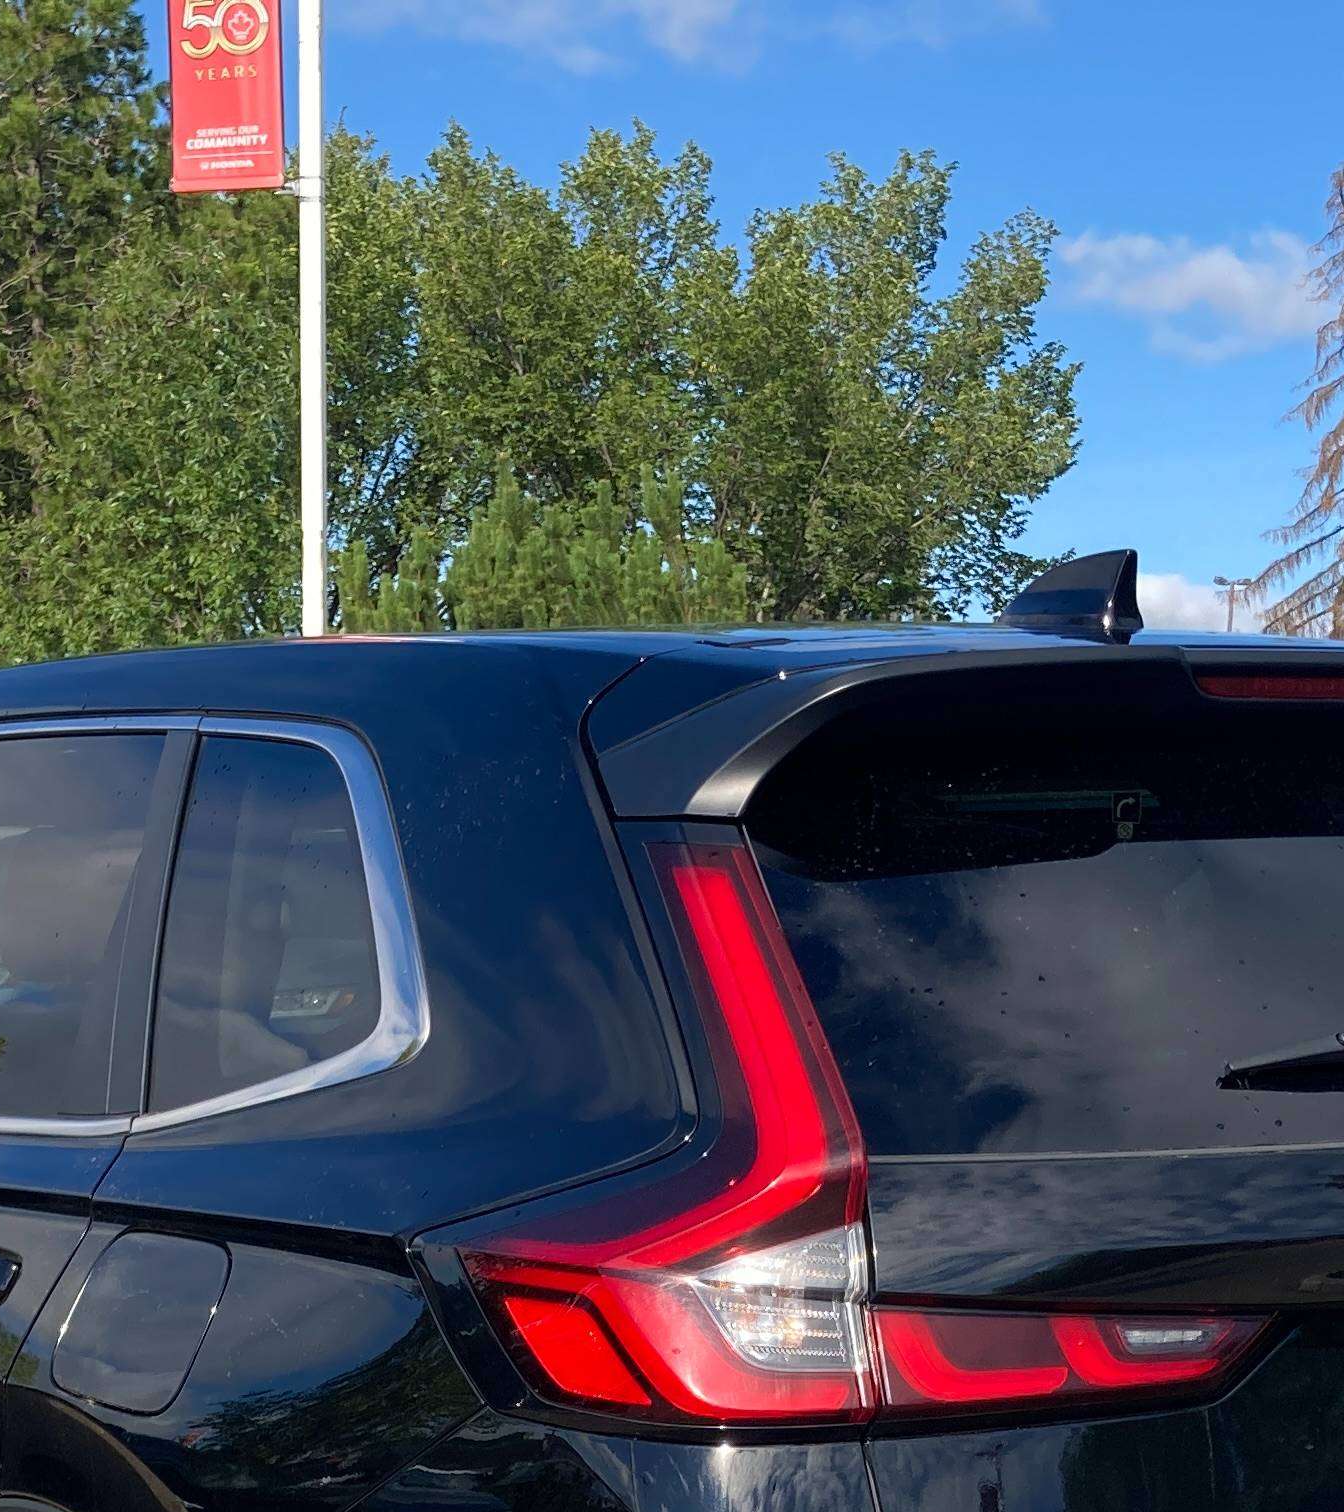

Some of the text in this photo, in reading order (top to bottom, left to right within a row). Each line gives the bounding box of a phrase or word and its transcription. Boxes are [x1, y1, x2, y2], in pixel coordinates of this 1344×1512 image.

[179, 0, 269, 60] 50
[194, 64, 257, 80] YEARS
[196, 125, 259, 138] SERVING OUR
[186, 134, 268, 150] COMMUNITY
[210, 160, 255, 169] HONDA
